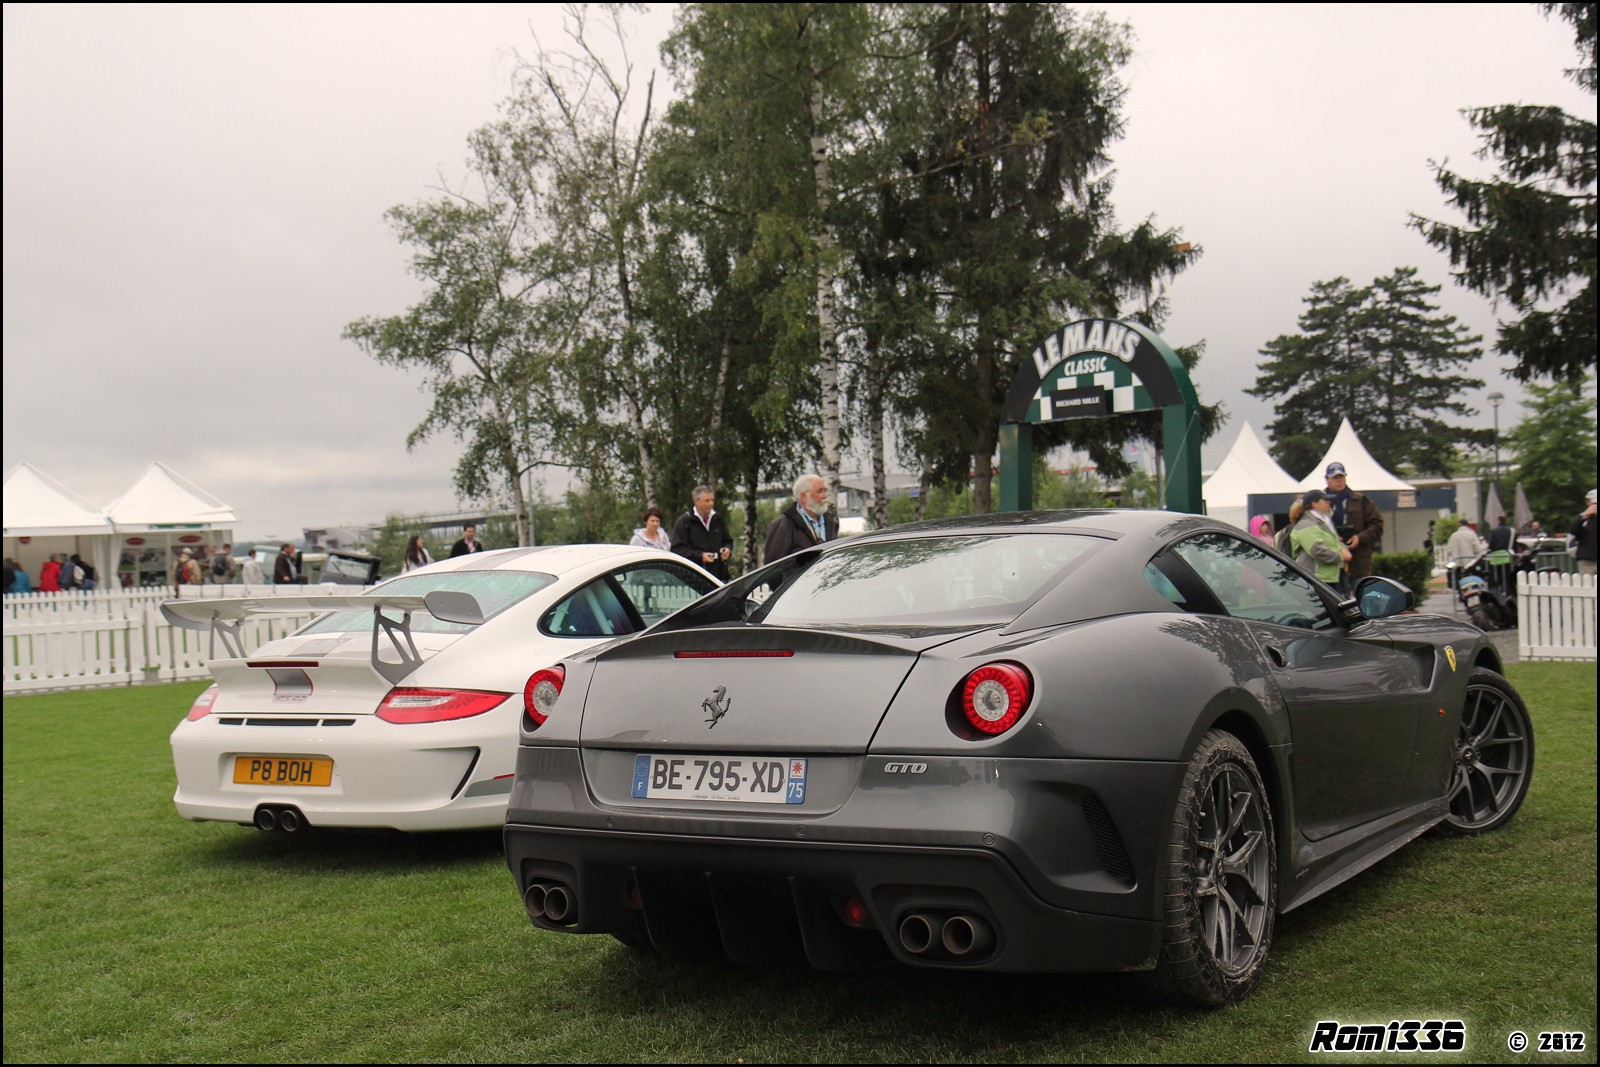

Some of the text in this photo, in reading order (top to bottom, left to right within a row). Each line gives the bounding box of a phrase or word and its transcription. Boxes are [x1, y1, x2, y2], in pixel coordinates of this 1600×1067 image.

[1033, 320, 1141, 379] LE MANS
[1064, 356, 1107, 376] CLASSIC
[1055, 396, 1099, 408] RICHARD MILLE
[250, 759, 313, 783] P8 BOH
[652, 759, 785, 793] BE-795-XD
[884, 761, 928, 775] GTO
[637, 781, 643, 792] F
[788, 782, 804, 799] 75
